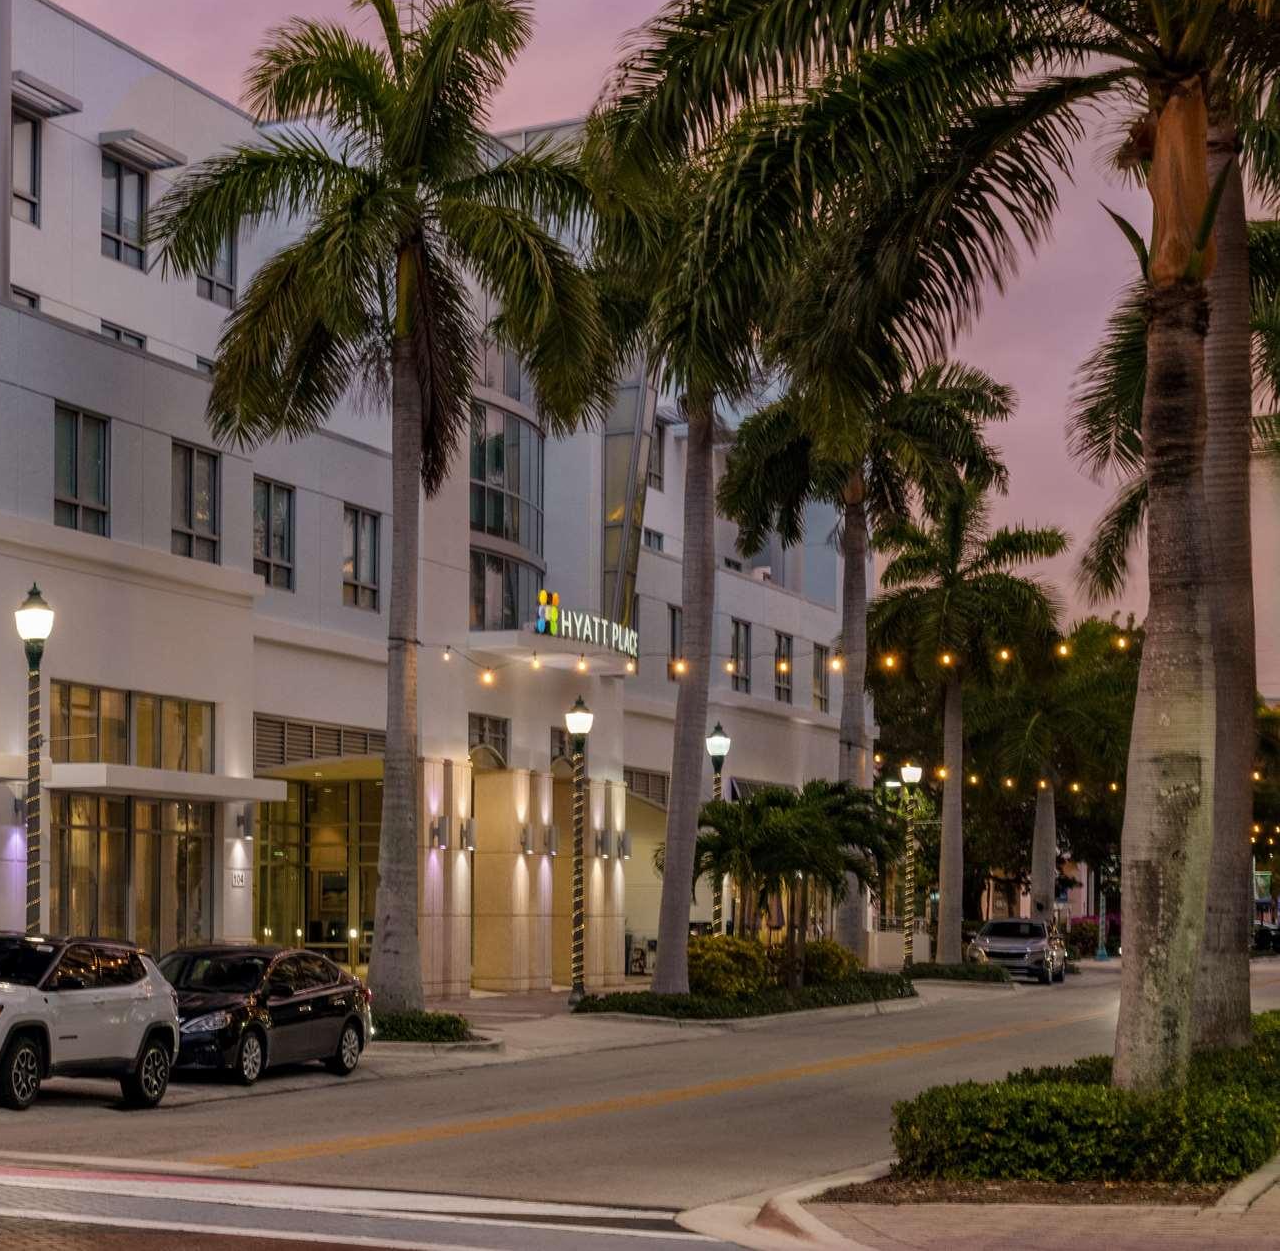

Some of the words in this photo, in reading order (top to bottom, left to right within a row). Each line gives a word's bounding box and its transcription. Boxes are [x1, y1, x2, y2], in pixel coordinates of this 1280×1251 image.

[561, 609, 609, 646] HYATT
[612, 622, 639, 657] PLACE
[233, 873, 244, 886] 104
